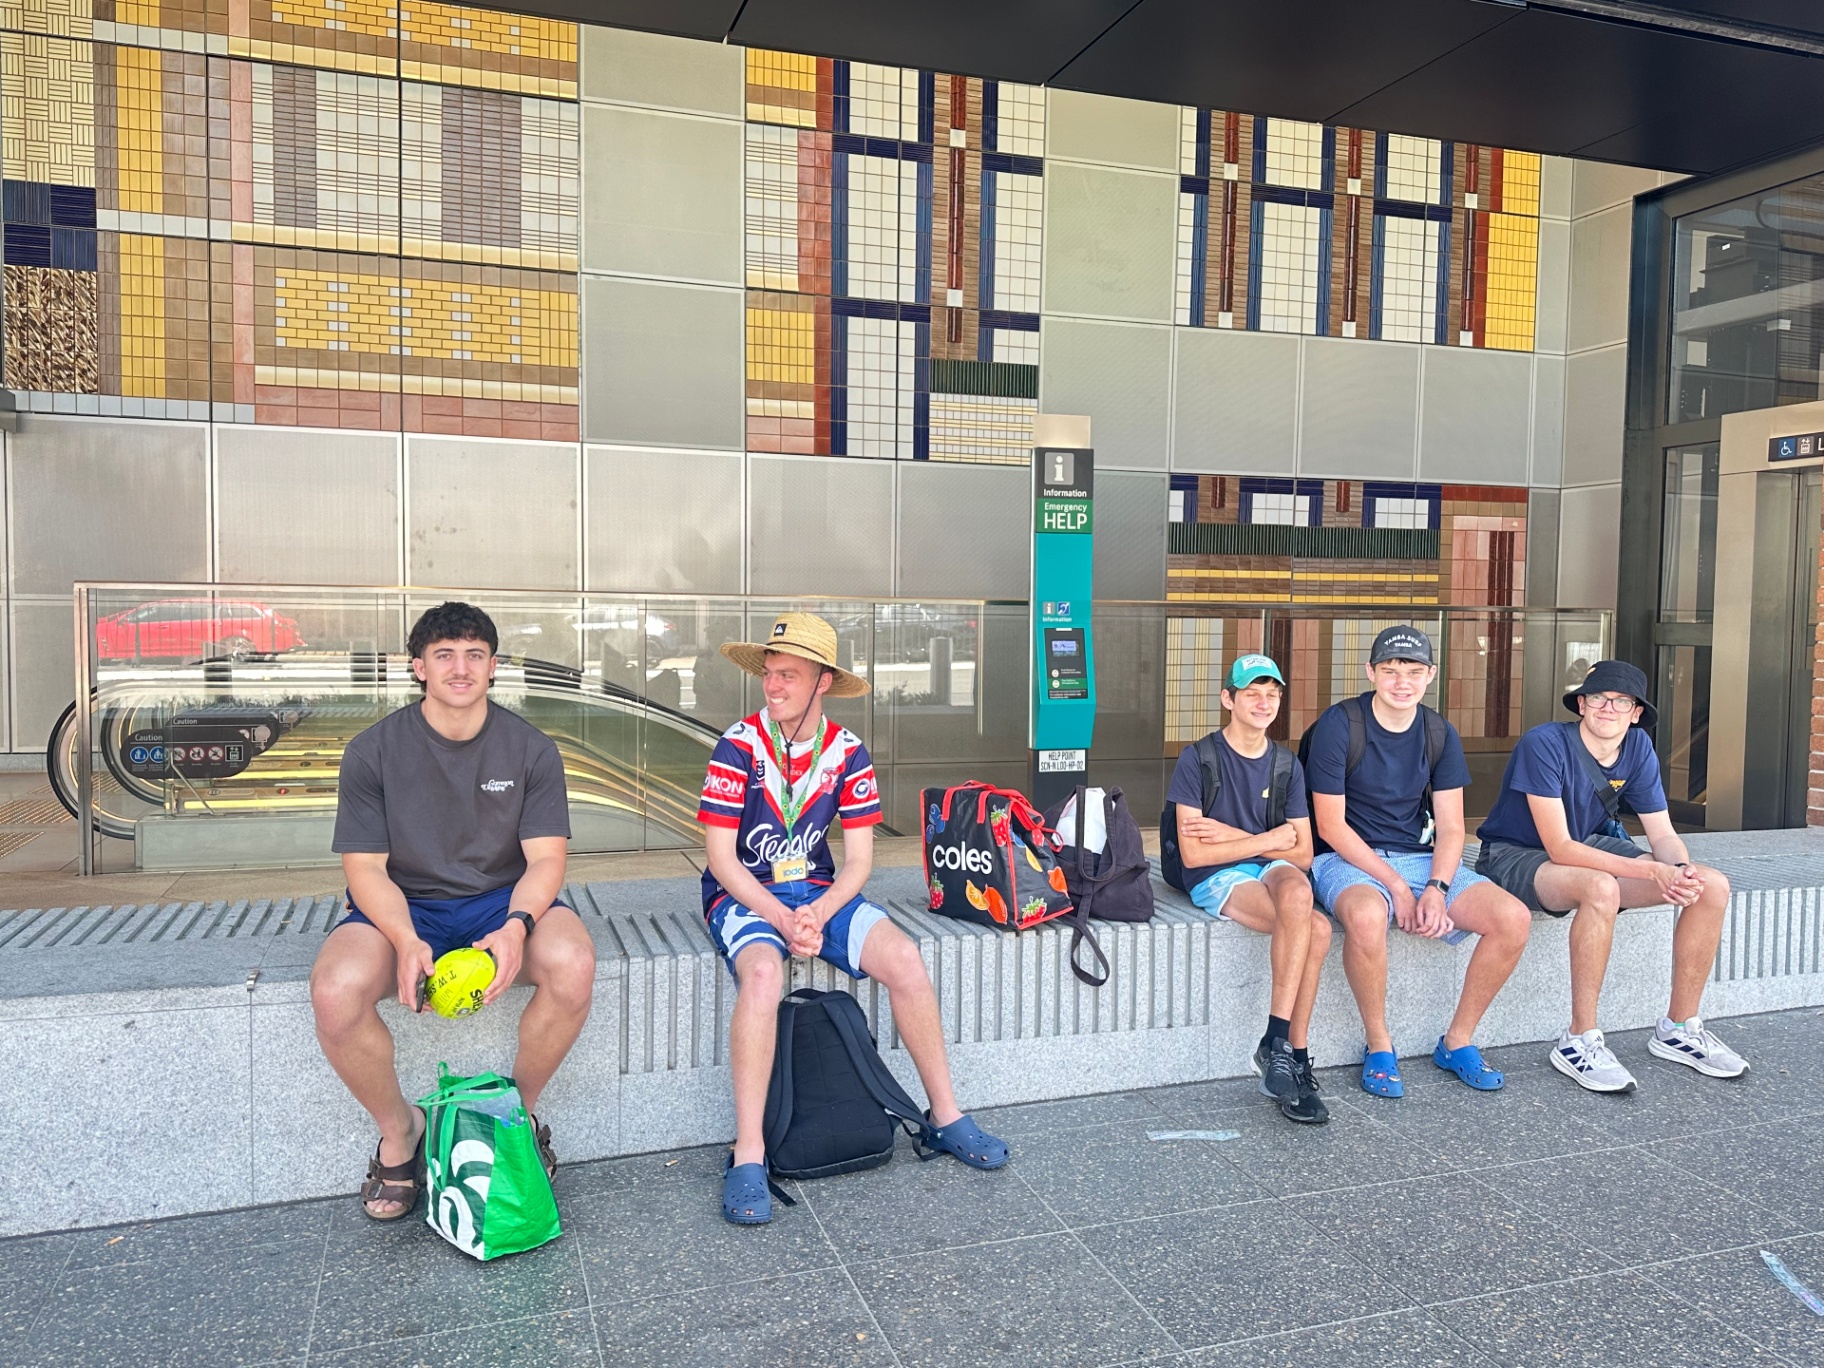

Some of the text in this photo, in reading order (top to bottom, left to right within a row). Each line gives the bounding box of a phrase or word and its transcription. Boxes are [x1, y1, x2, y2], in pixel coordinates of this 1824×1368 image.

[1043, 488, 1087, 497] Information
[1044, 502, 1088, 512] Emergency
[1044, 512, 1088, 530] HELP
[932, 841, 993, 875] coles
